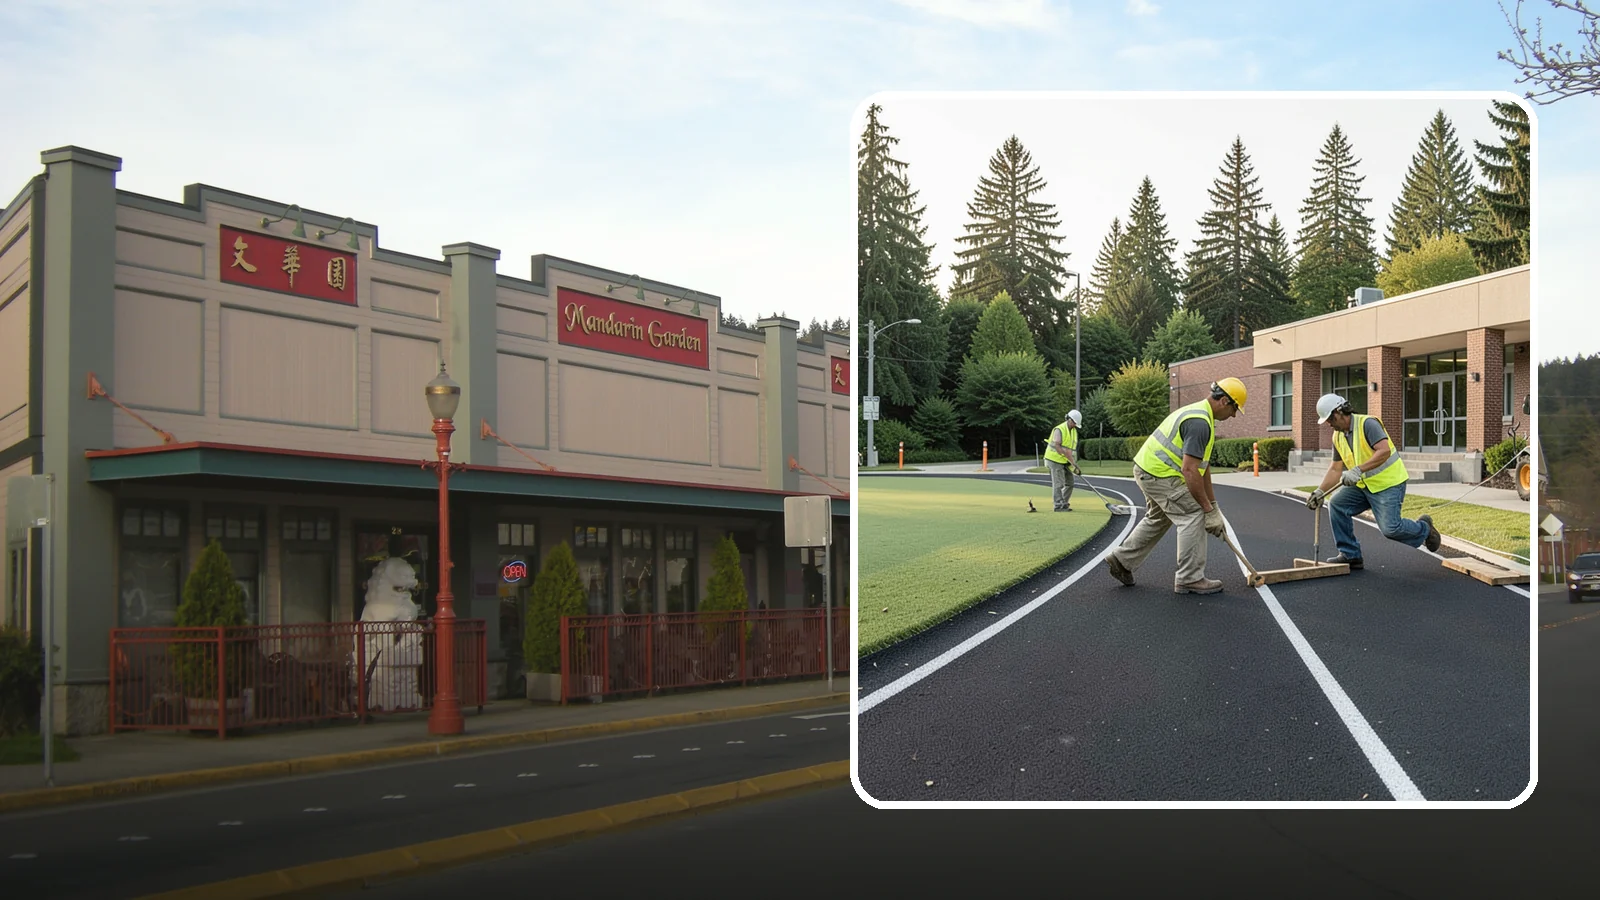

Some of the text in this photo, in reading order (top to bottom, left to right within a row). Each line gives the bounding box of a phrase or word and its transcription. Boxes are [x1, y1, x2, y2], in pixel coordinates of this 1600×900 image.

[231, 235, 346, 291] 文華園
[564, 302, 702, 352] Mandarin Garden
[503, 565, 527, 578] OPEN
